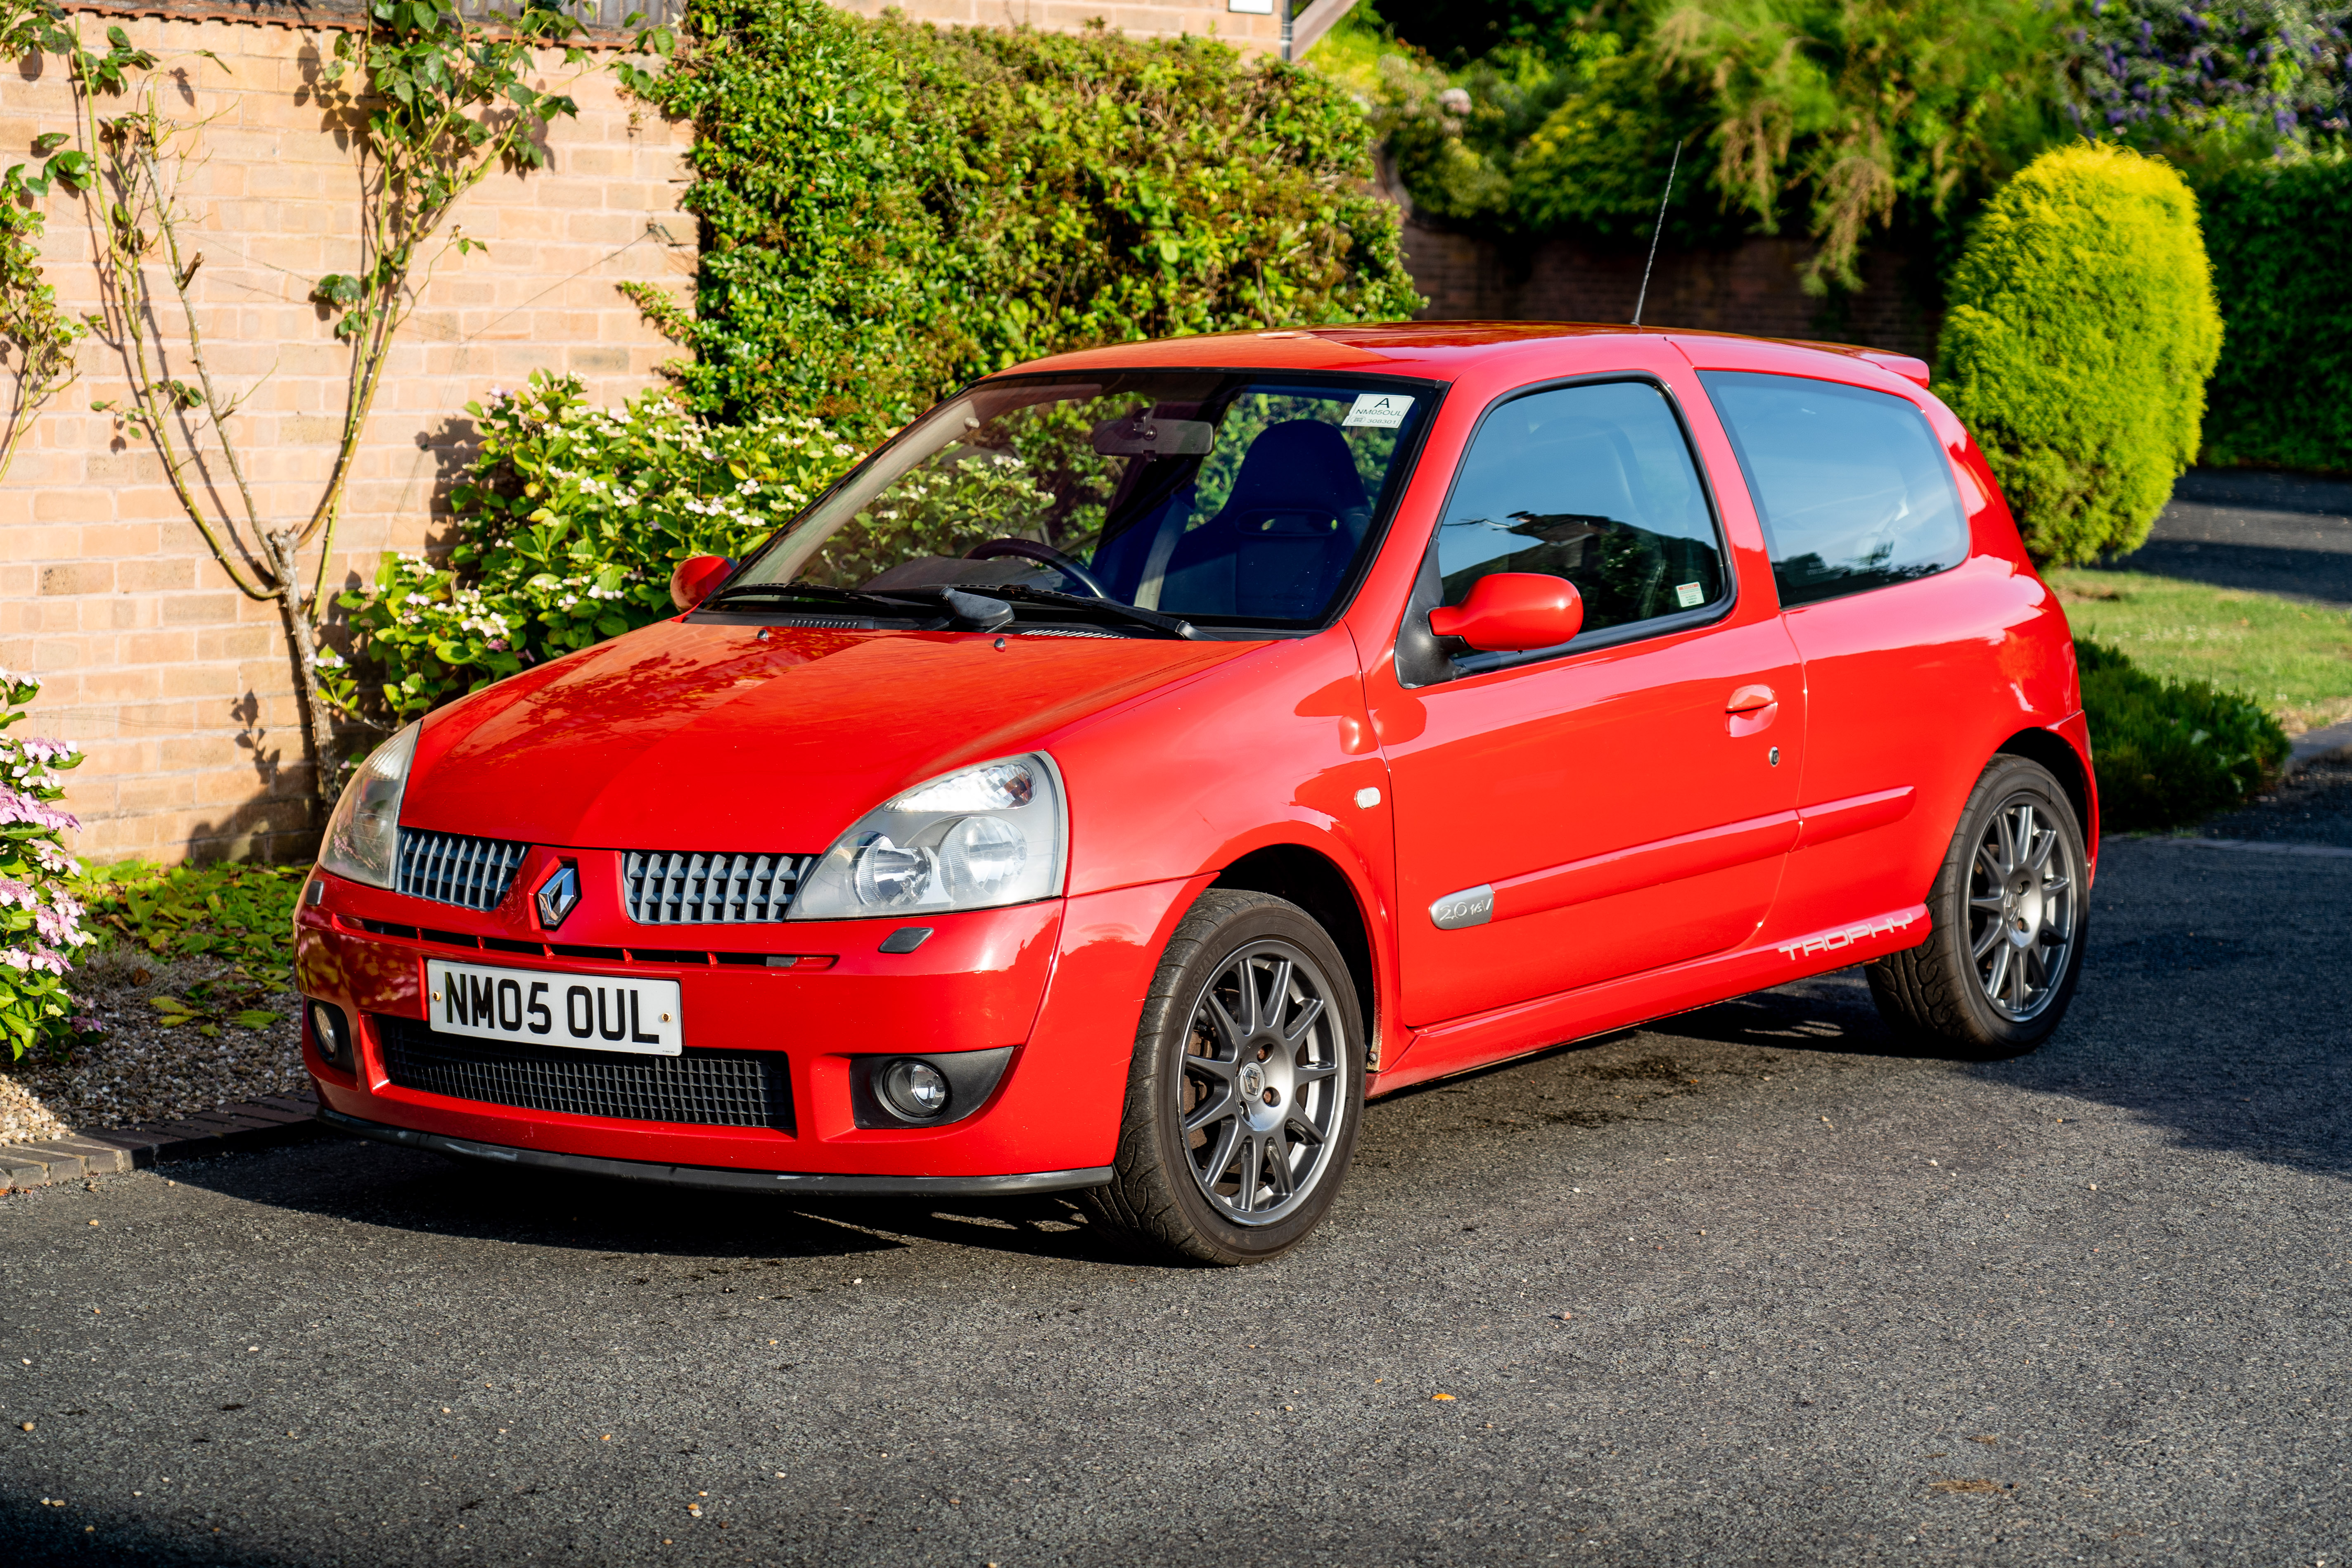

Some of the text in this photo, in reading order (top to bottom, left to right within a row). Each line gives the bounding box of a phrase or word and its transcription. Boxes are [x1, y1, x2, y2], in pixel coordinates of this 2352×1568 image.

[1374, 398, 1389, 408] A
[1778, 913, 1913, 961] TROPHY
[1180, 944, 1224, 1011] YOKOHAMA
[445, 971, 659, 1044] NM05 OUL
